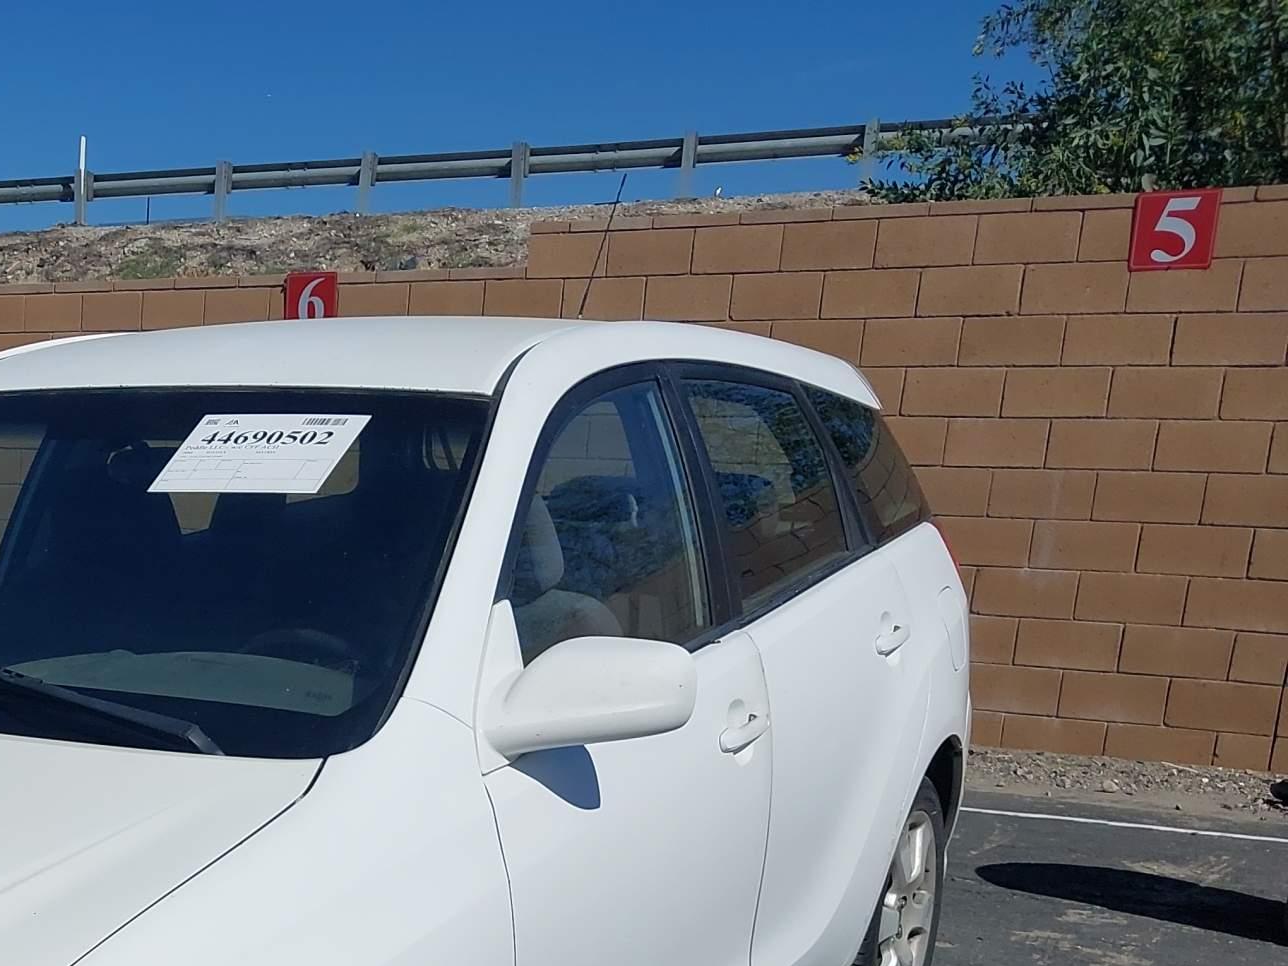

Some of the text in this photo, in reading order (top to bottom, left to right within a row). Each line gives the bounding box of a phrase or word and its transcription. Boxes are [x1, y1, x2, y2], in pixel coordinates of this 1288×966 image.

[1150, 196, 1202, 263] 5
[298, 277, 325, 320] 6
[200, 430, 335, 445] 44690502
